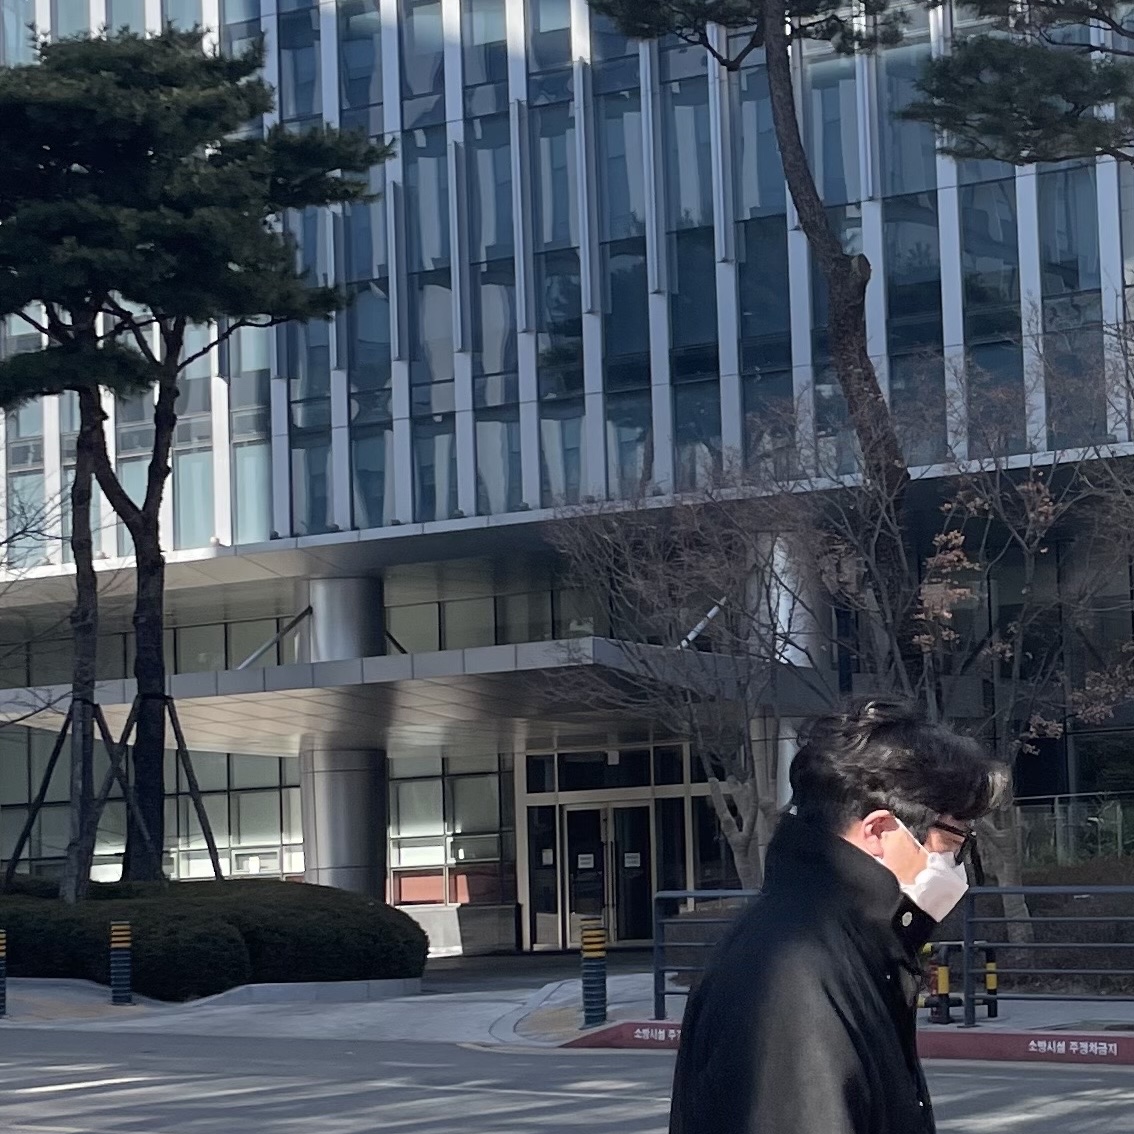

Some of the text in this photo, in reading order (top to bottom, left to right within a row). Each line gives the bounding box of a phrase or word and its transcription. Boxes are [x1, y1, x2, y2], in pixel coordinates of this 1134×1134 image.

[634, 1028, 665, 1040] 소방시설
[1028, 1040, 1118, 1056] 소방시설 주정차금지
